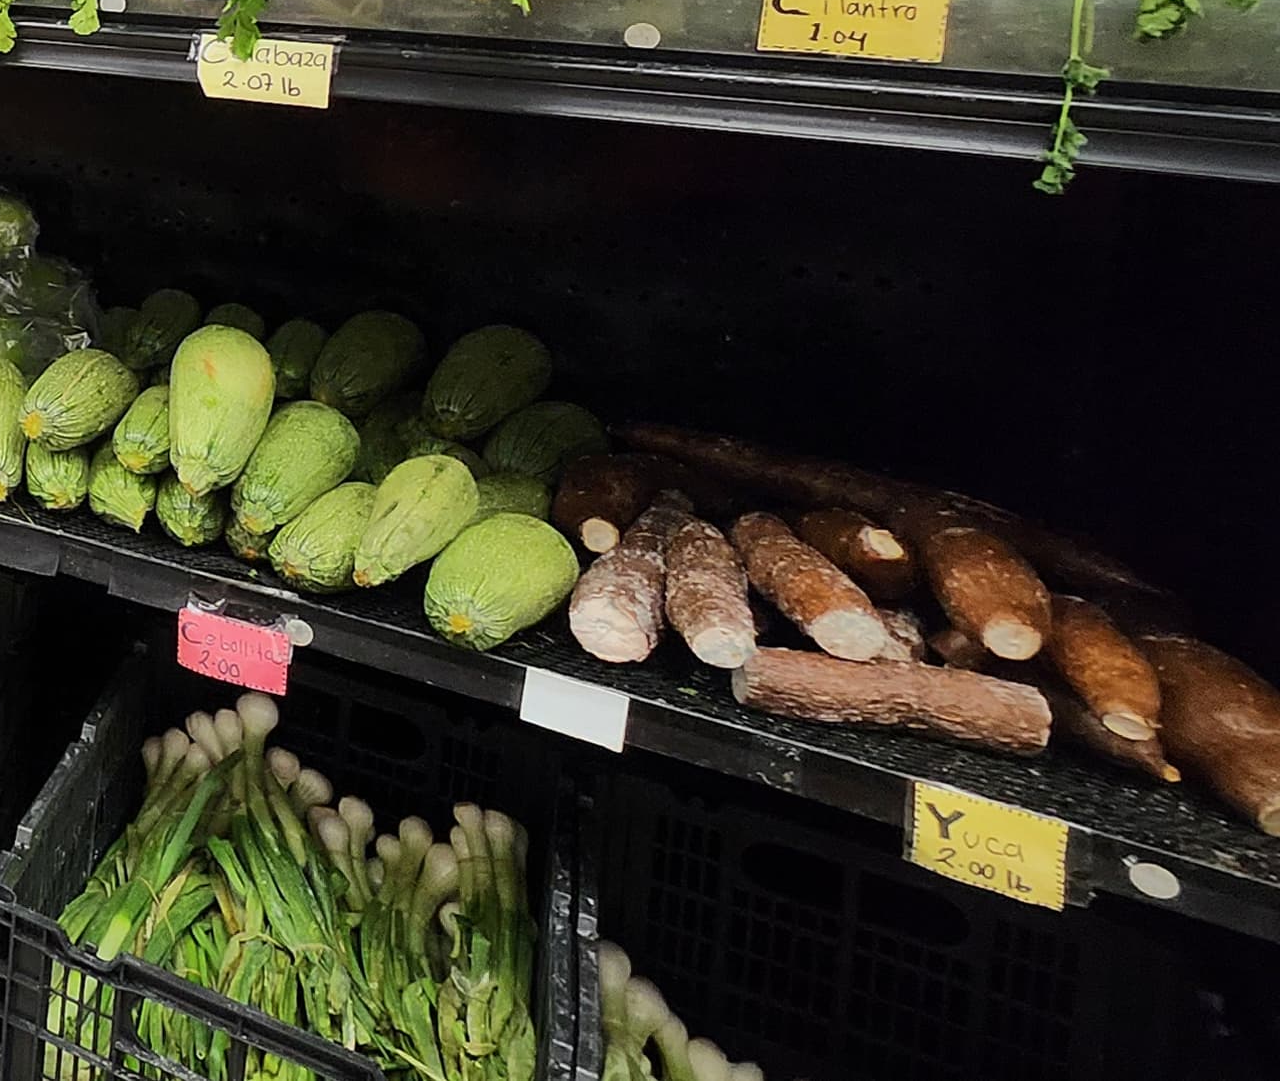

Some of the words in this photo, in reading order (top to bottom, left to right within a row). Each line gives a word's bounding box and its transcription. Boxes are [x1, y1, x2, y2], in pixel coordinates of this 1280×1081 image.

[808, 21, 868, 52] 1.04
[201, 38, 327, 71] Cabaza
[222, 70, 273, 92] 2.07
[281, 76, 301, 97] lb
[198, 649, 241, 678] 2.00
[923, 801, 1025, 863] Yuca
[934, 847, 996, 881] 2.00
[1006, 870, 1033, 894] lb
